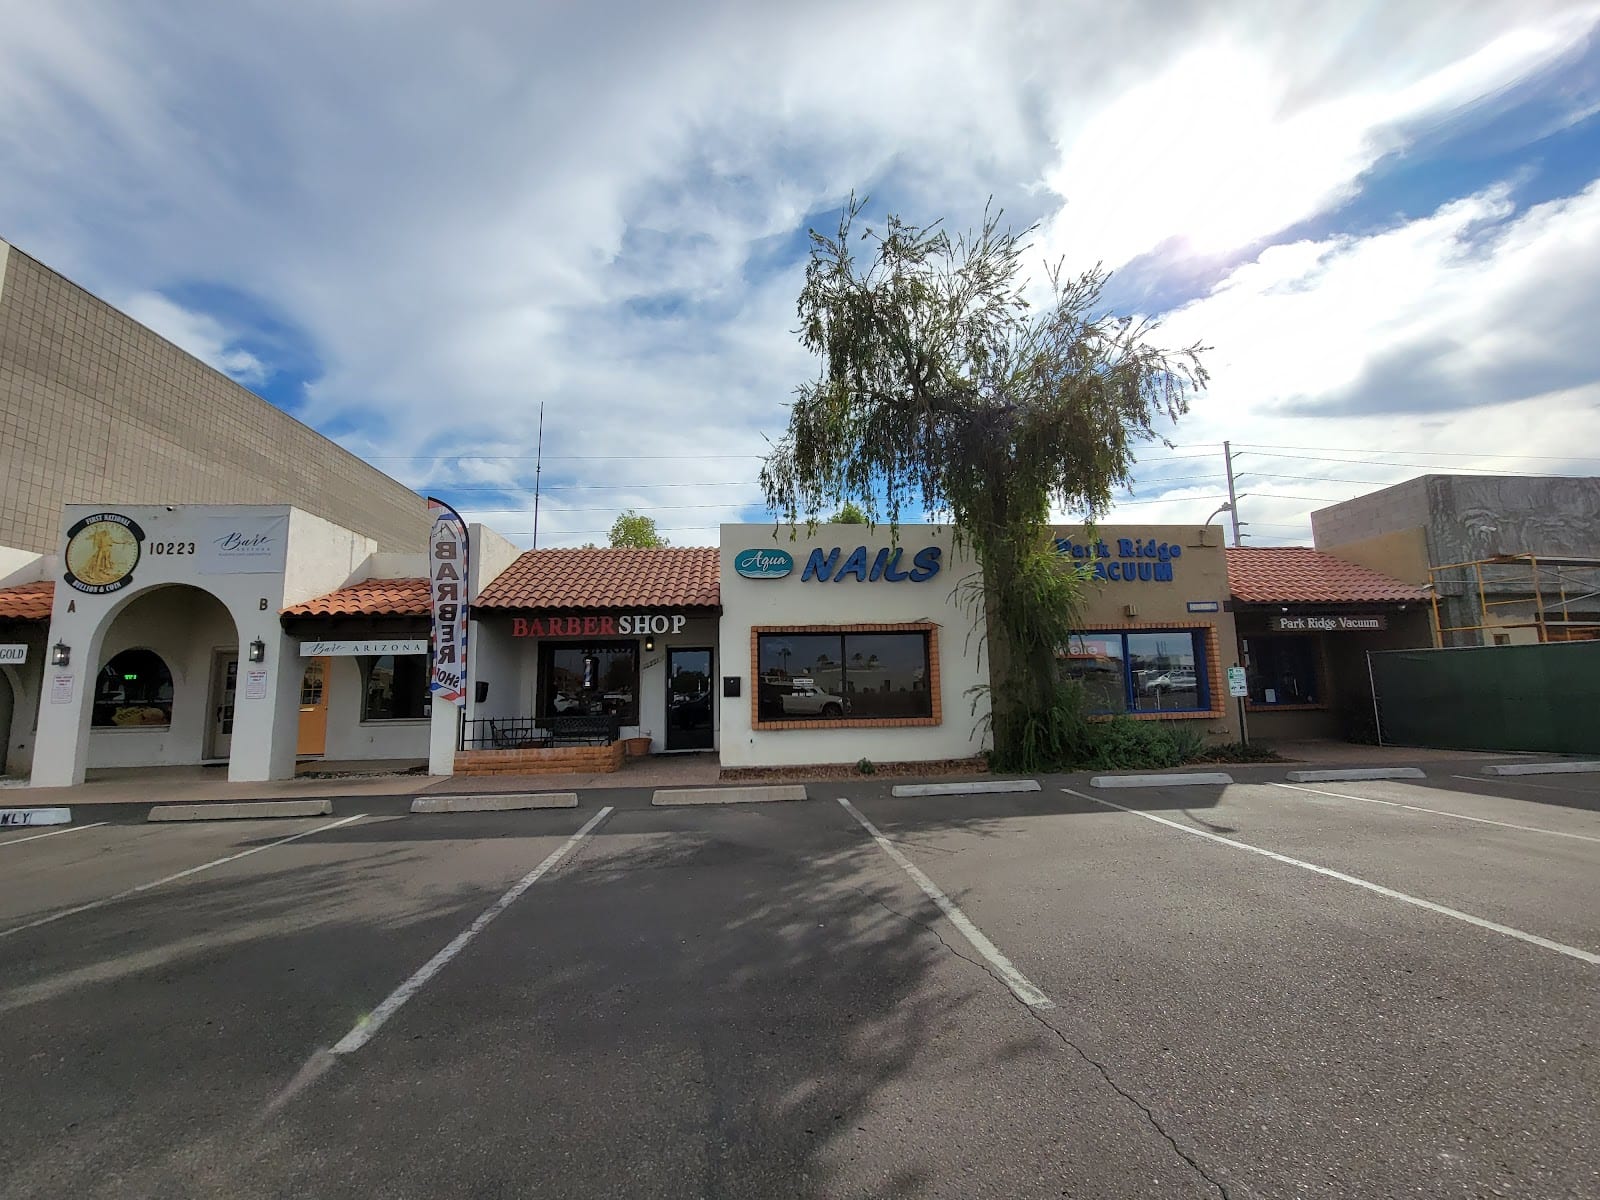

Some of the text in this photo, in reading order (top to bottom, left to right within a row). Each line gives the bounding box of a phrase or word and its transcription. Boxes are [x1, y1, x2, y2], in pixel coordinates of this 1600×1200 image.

[149, 542, 195, 555] 10223
[1117, 538, 1182, 562] Ridge
[741, 550, 788, 571] Aqua
[801, 546, 942, 583] NAILS
[106, 581, 122, 592] COIN
[67, 600, 76, 613] A
[259, 598, 268, 611] B
[512, 615, 686, 637] BARBER SHOP
[1280, 617, 1379, 631] Park Ridge Vacuum
[0, 649, 24, 659] GOLD
[352, 644, 420, 653] ARIZONA
